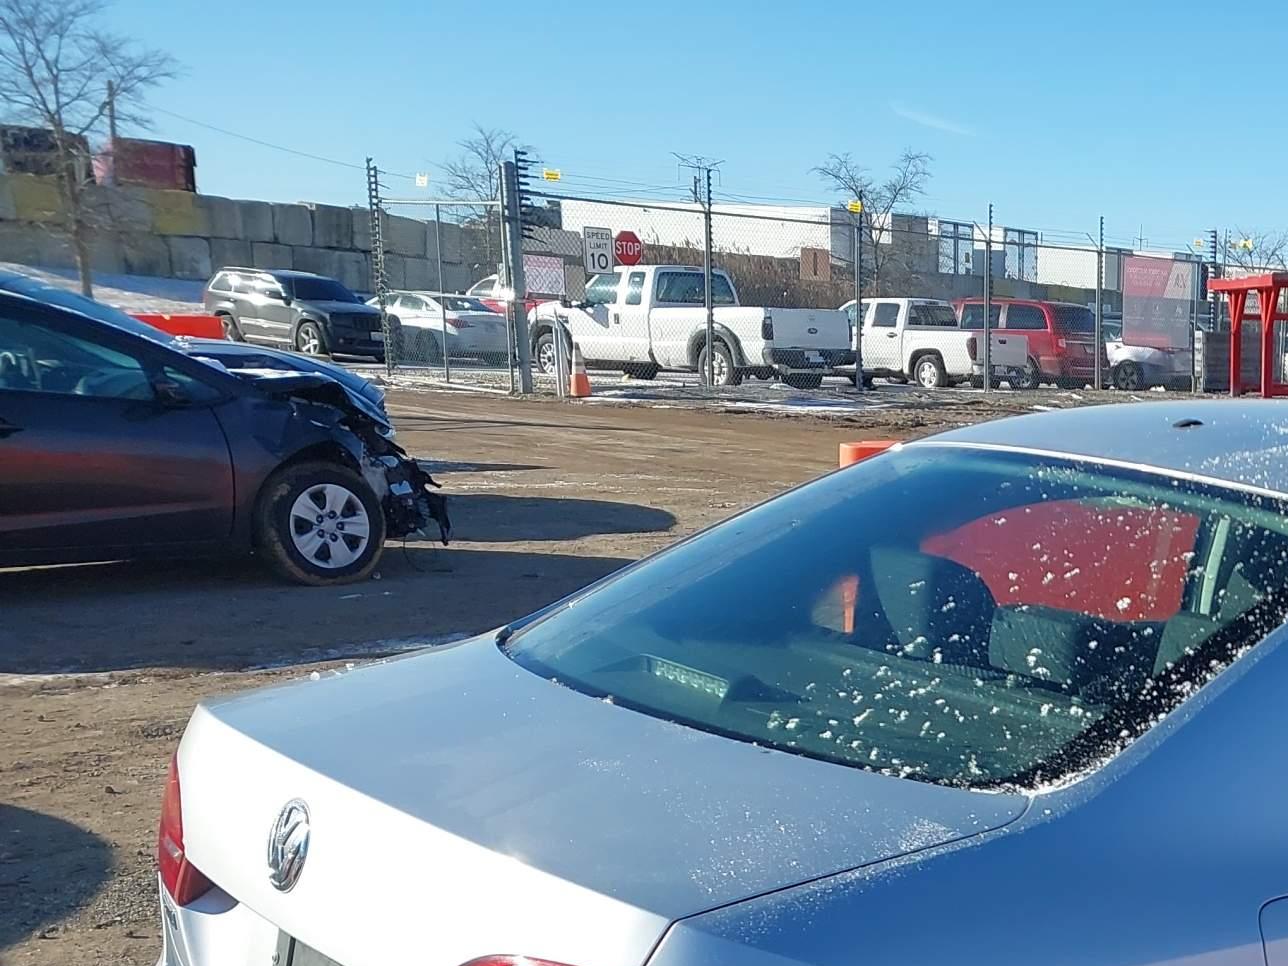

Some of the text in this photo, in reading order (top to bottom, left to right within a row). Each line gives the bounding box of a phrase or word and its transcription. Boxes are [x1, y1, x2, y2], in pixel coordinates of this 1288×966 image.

[587, 232, 610, 240] SPEED
[615, 242, 641, 256] STOP
[590, 253, 609, 270] 10
